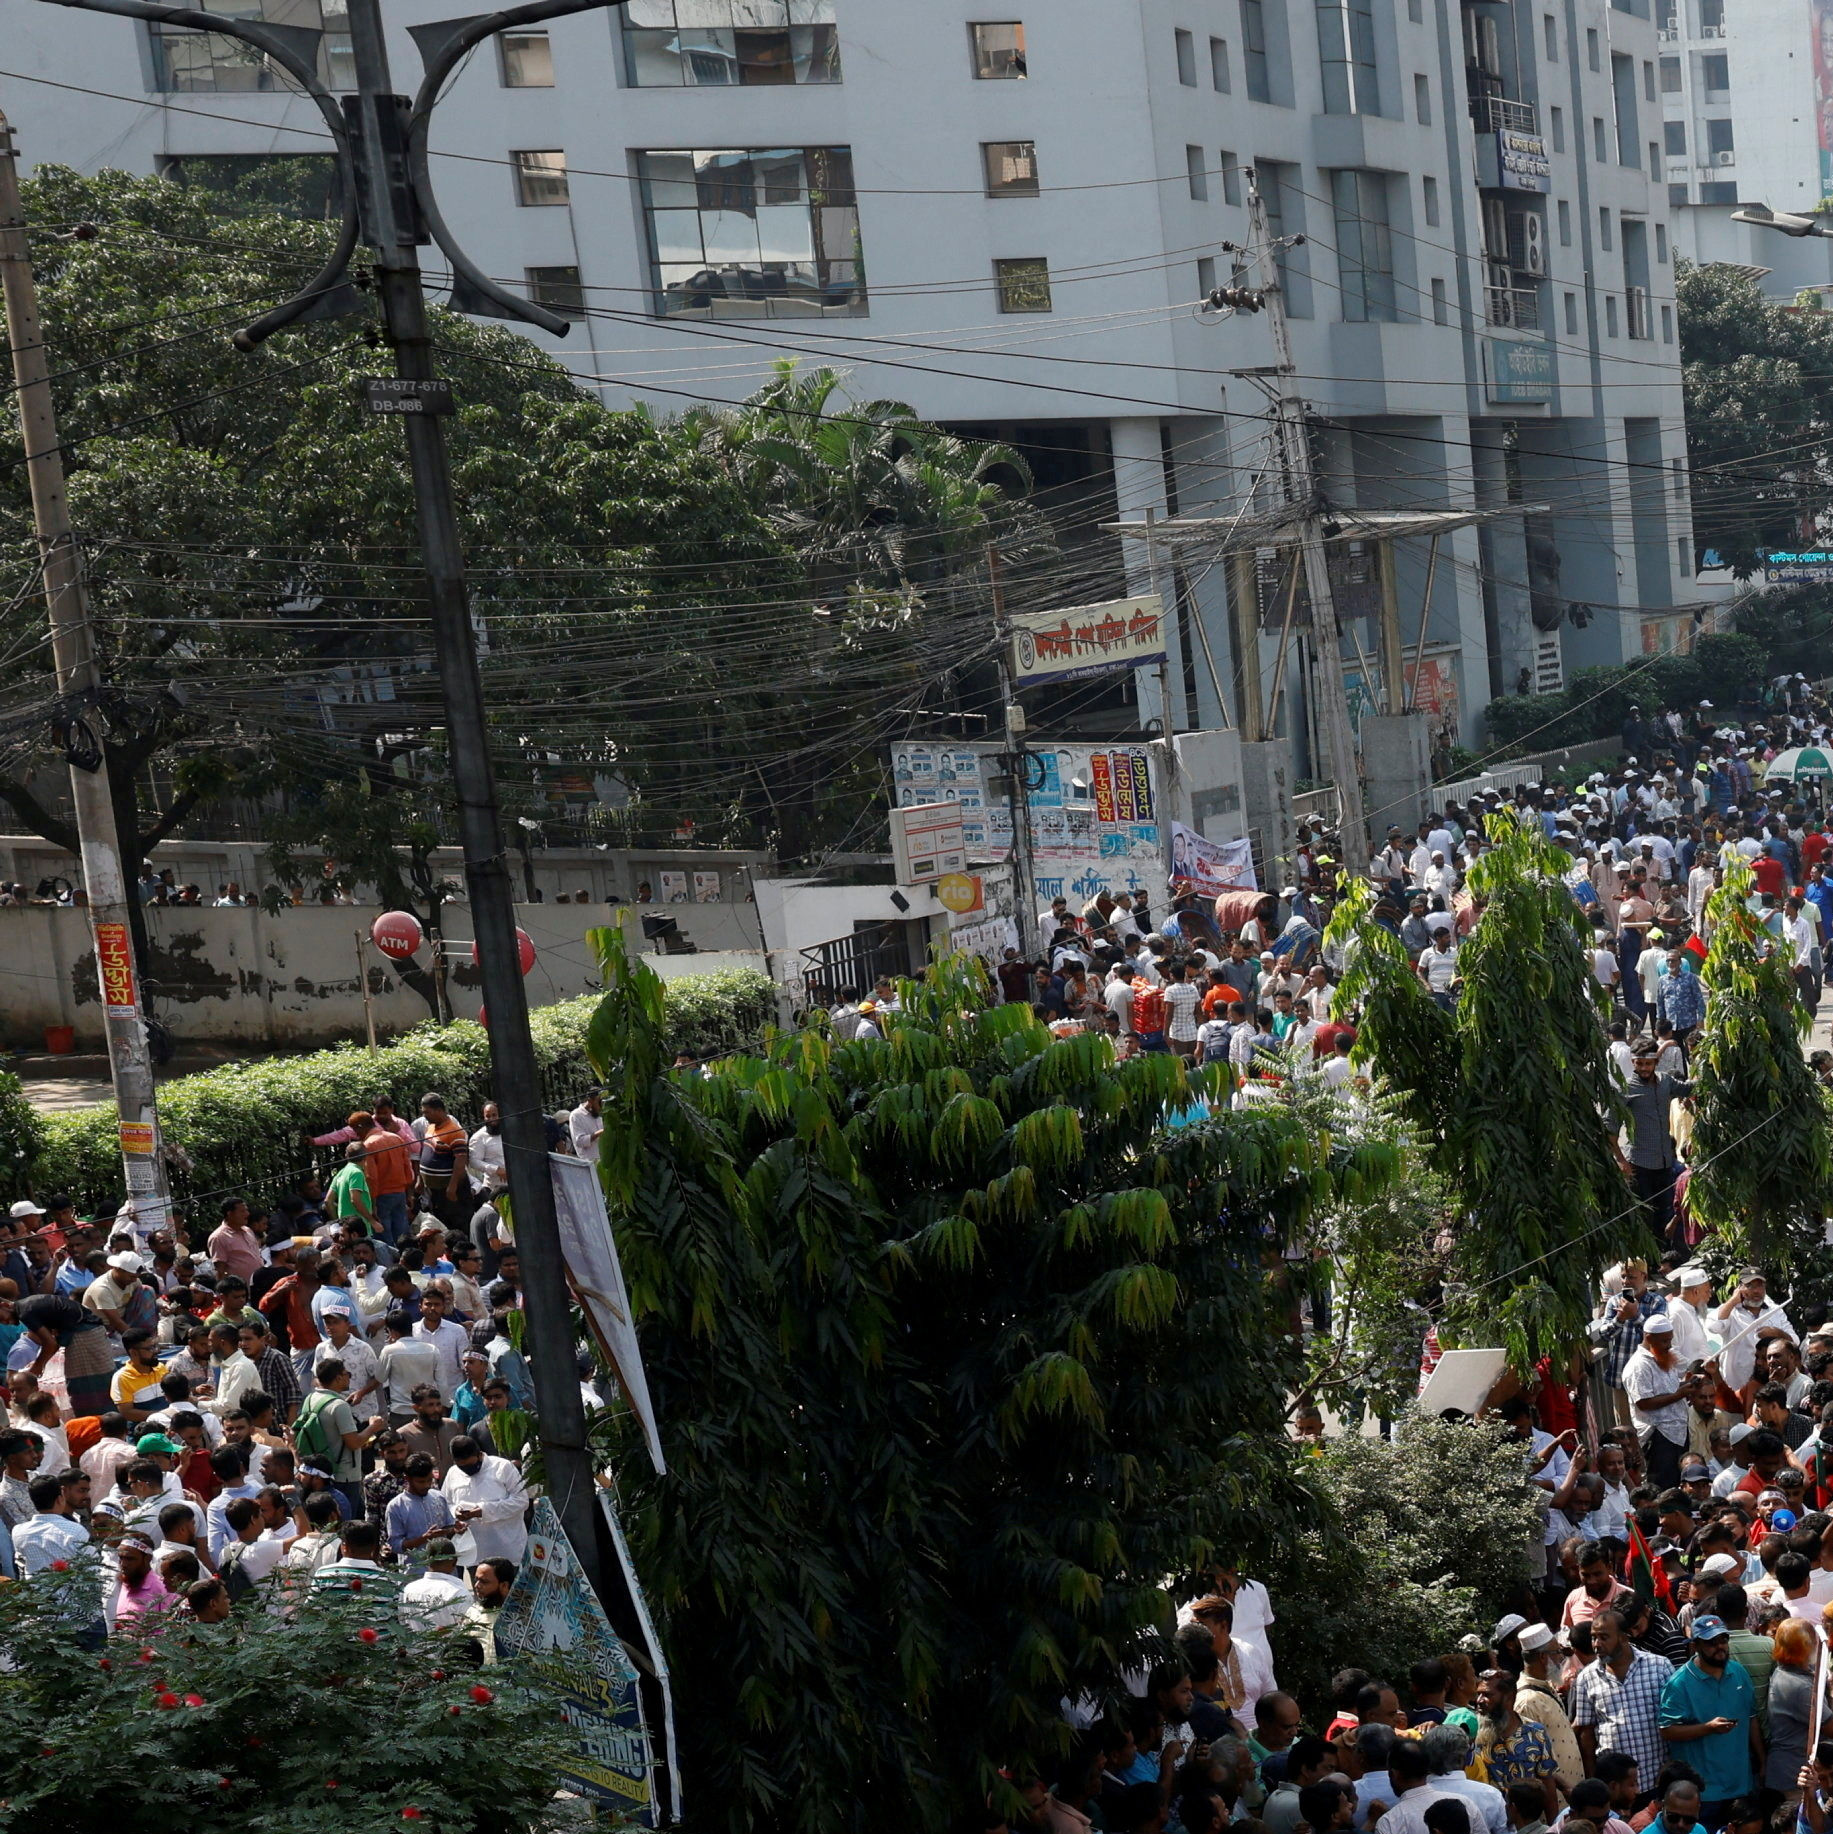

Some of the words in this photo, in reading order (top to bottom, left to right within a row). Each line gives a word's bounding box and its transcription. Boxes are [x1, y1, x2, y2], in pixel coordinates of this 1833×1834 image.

[373, 400, 423, 411] DB-086
[1130, 748, 1146, 757] BCS
[942, 879, 972, 899] ria
[381, 937, 409, 950] ATM
